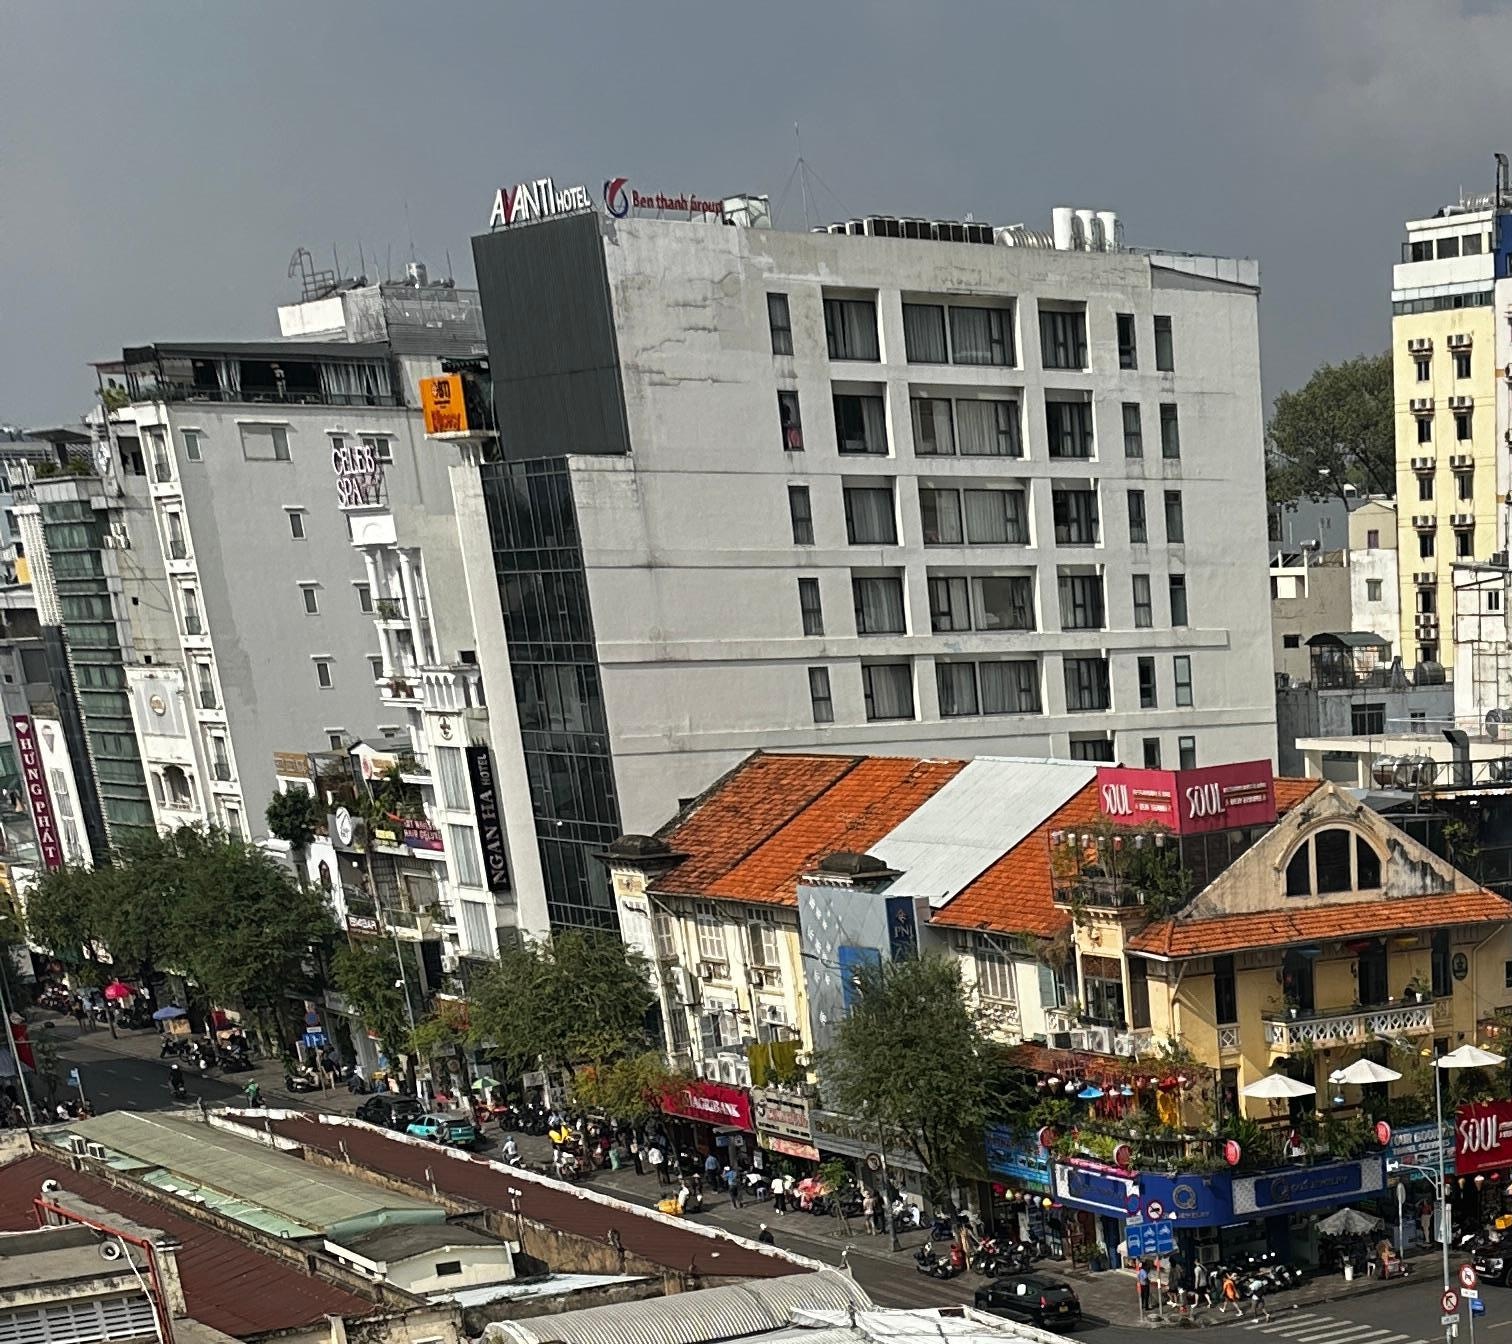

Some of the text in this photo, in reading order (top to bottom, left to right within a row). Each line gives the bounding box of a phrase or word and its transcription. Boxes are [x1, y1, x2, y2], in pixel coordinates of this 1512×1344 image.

[490, 176, 591, 228] AVANTI HOTEL
[632, 190, 653, 208] Ben
[656, 194, 689, 211] thanh
[332, 445, 375, 475] CELEB
[336, 478, 363, 505] SPA
[476, 753, 492, 787] HOTEL
[1102, 783, 1134, 816] SOUL
[1186, 782, 1226, 819] SOUL
[1459, 1114, 1501, 1155] SOUL
